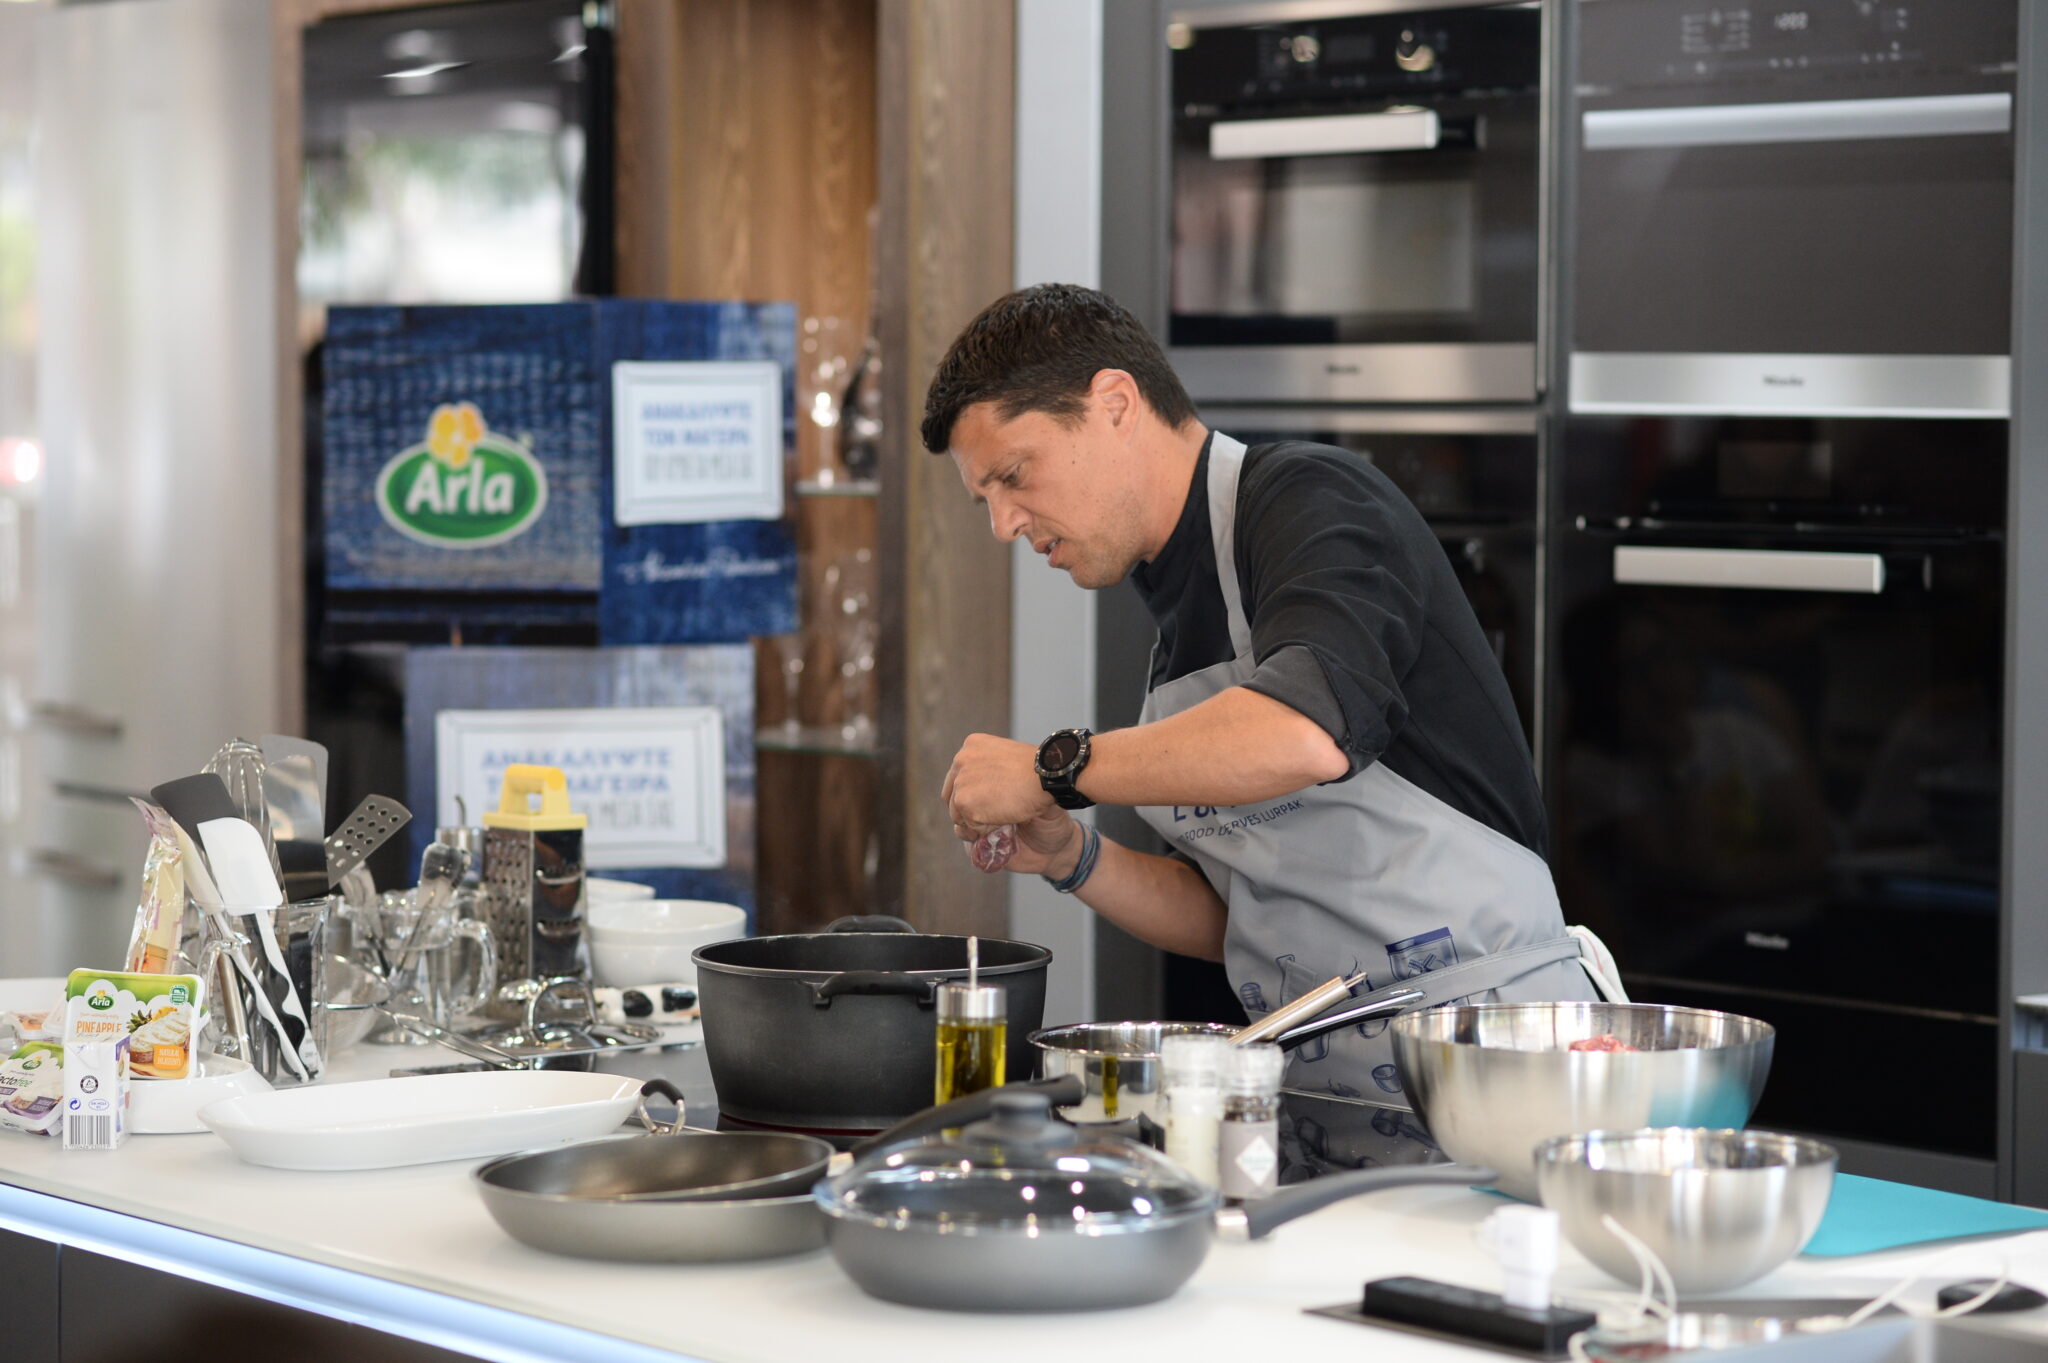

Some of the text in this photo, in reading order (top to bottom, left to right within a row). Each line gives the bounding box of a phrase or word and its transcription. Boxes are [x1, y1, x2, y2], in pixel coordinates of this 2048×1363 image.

[404, 457, 516, 514] Arla
[566, 774, 670, 794] ΑΓΕΙΡΑ
[1260, 799, 1305, 822] LURPAK
[91, 997, 111, 1007] Arla
